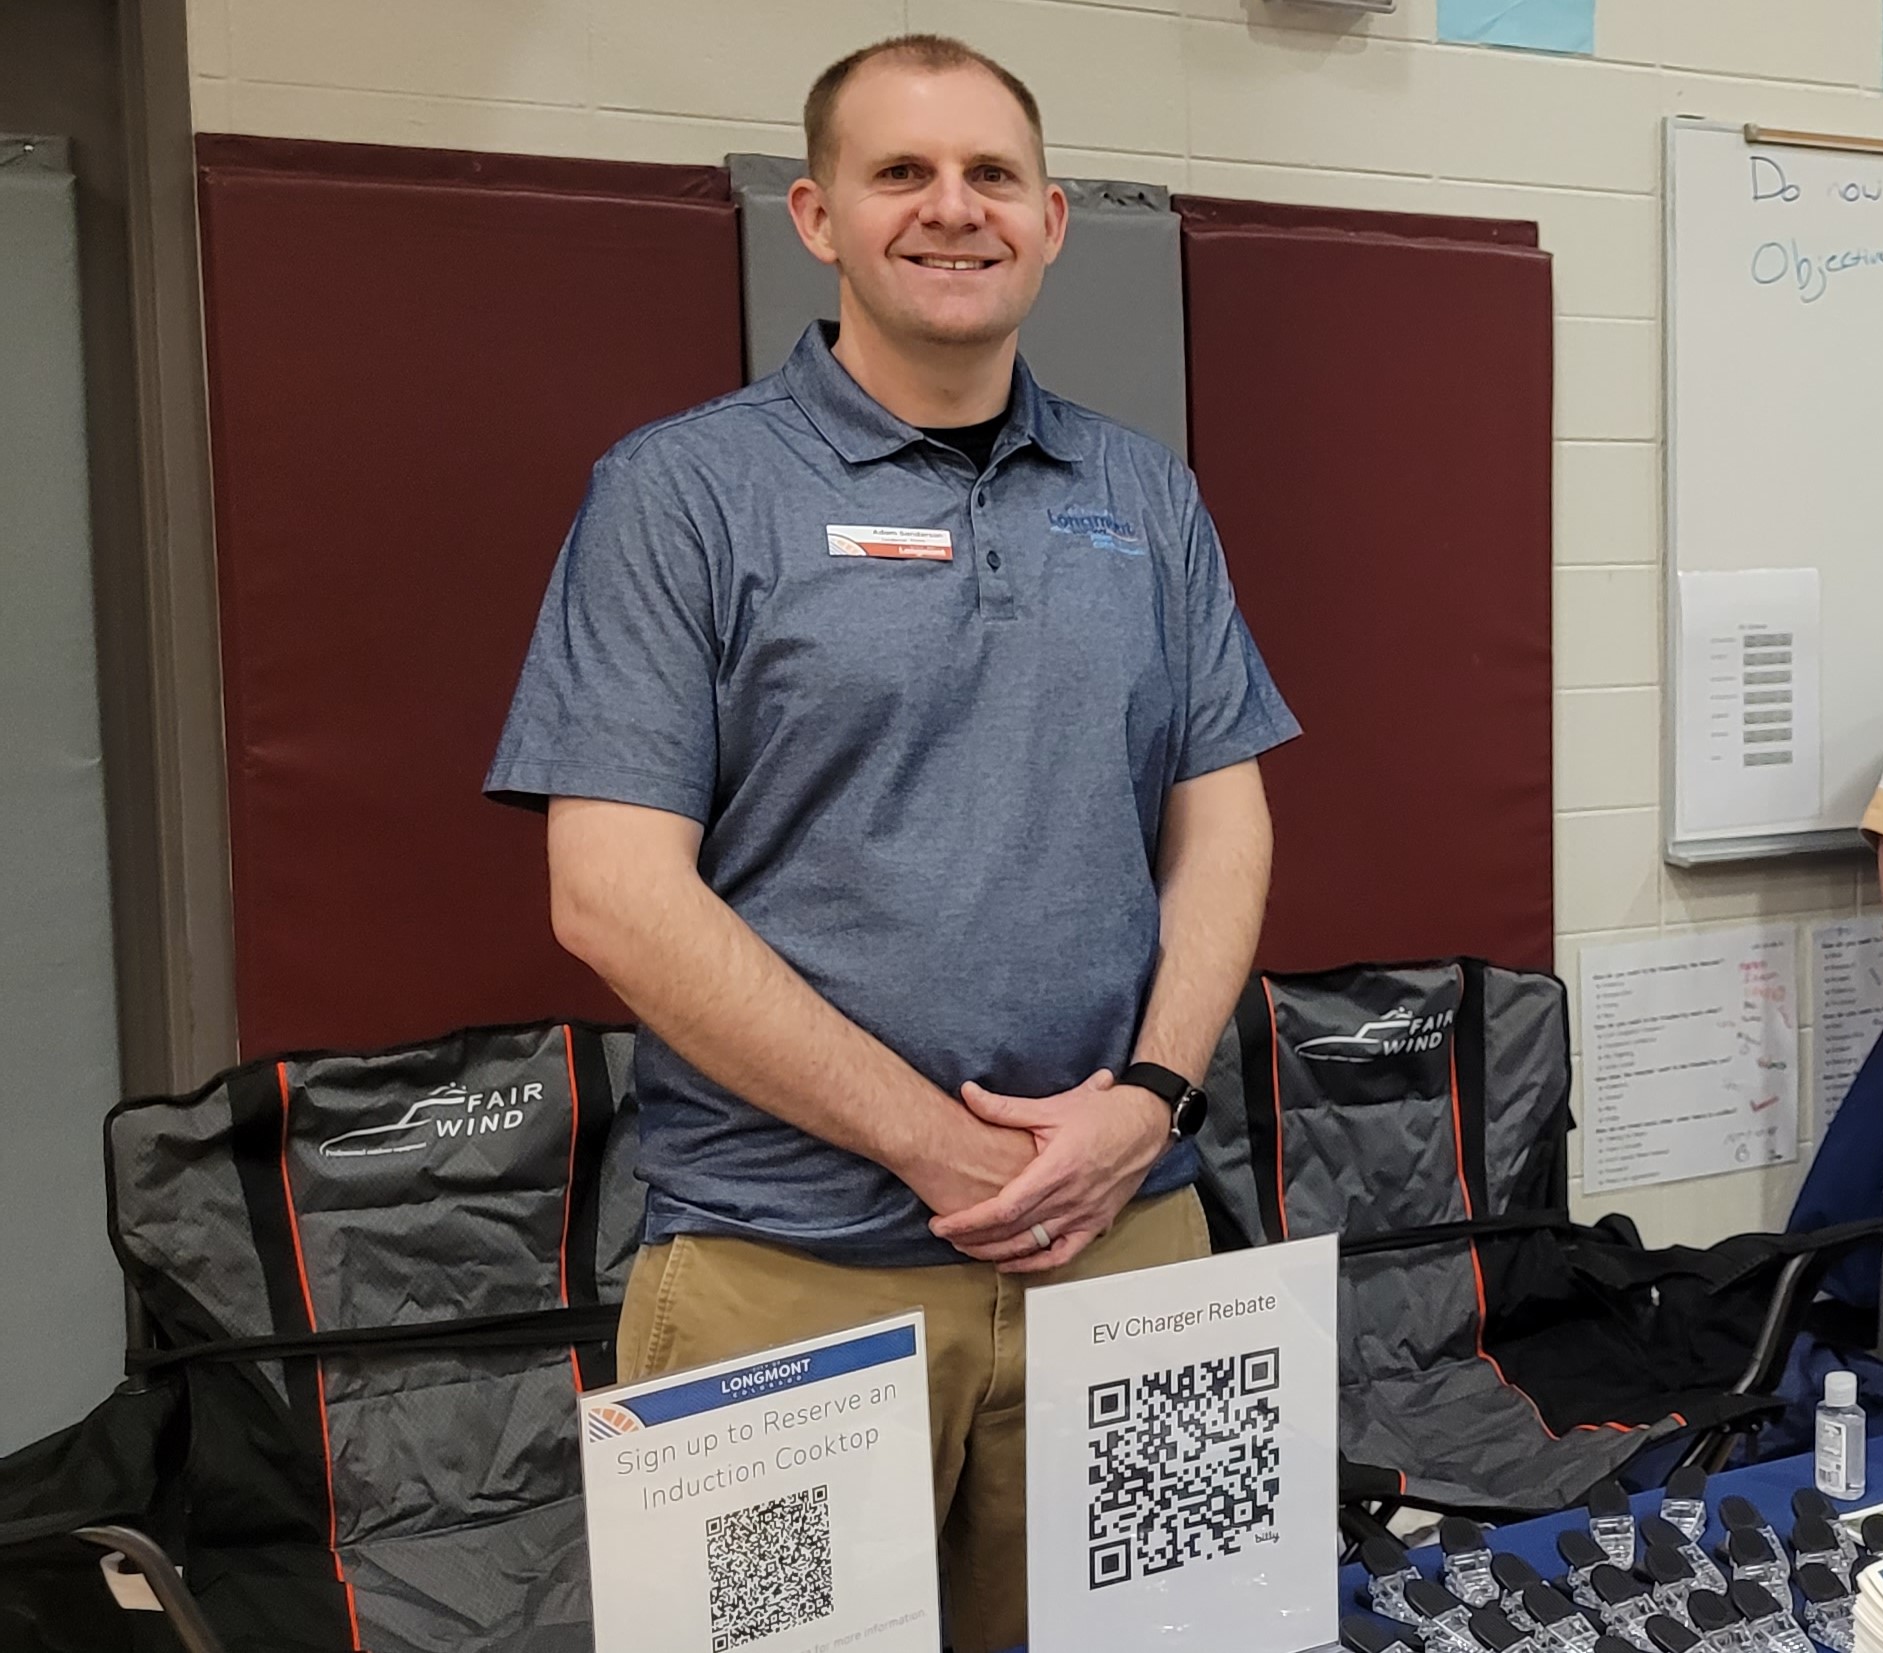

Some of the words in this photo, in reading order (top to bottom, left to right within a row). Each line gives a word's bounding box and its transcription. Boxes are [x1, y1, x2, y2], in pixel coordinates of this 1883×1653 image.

[1750, 156, 1801, 202] Do
[1408, 1010, 1454, 1036] FAIR
[1382, 1031, 1443, 1057] WIND
[466, 1082, 543, 1113] FAIR
[435, 1109, 524, 1138] WIND
[1092, 1321, 1121, 1345] EV
[1125, 1309, 1203, 1337] Charger
[1208, 1295, 1276, 1321] Rebate
[721, 1358, 812, 1394] LONGMONT
[732, 1375, 802, 1399] COLORADO
[617, 1444, 676, 1475] Sign
[686, 1433, 719, 1457] up
[727, 1423, 753, 1445] to
[763, 1393, 861, 1435] Reserve
[870, 1383, 897, 1406] an
[642, 1459, 766, 1510] Induction
[775, 1427, 880, 1471] Cooktop
